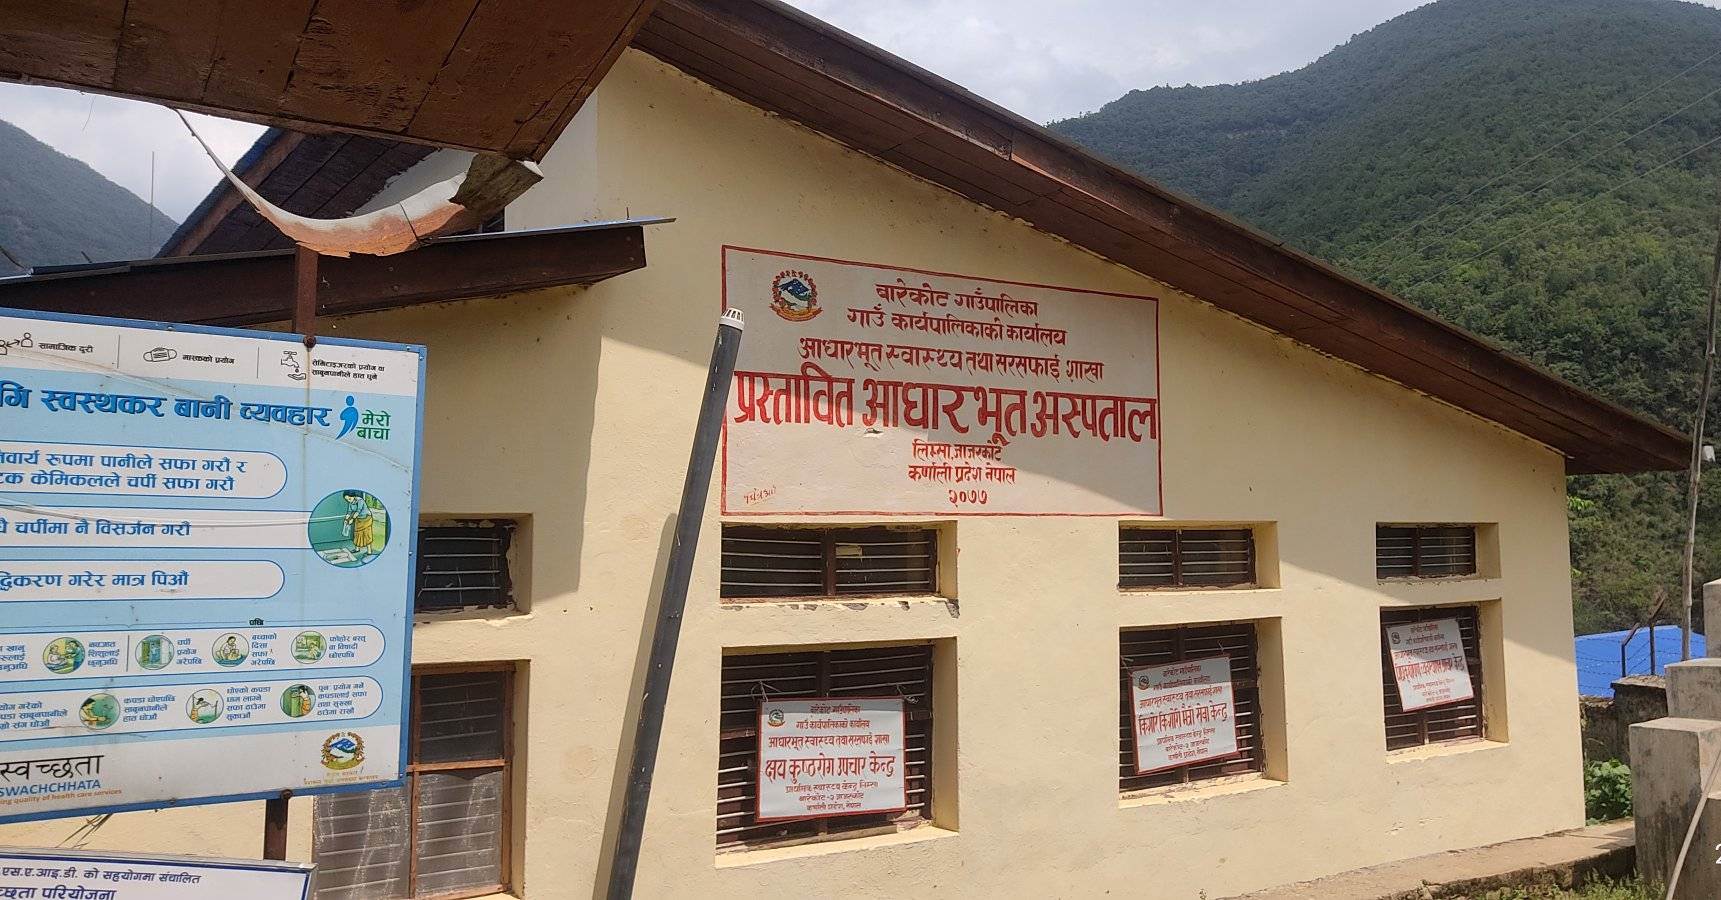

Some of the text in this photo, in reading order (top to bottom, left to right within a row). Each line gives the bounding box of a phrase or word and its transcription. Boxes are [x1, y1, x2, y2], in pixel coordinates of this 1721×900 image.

[875, 278, 1039, 317] बारेकोट गाउँपालिका
[847, 303, 1068, 347] गाउँ कार्यपालिकाको कार्यालय
[38, 342, 77, 352] सामाजिक
[182, 354, 236, 365] मास्कको प्रयोग
[358, 363, 377, 372] प्रयोग
[799, 337, 883, 372] आधारभूत
[966, 352, 993, 375] तथा
[995, 354, 1060, 383] सरसफाई
[1066, 359, 1104, 383] शाखा
[41, 389, 167, 417] स्वस्थकर
[174, 393, 232, 420] बानी
[240, 402, 332, 427] व्यवहार
[734, 361, 855, 427] प्रस्तावित
[1031, 390, 1158, 442] अस्पताल
[361, 409, 391, 427] मेरो
[356, 427, 391, 440] बाचा
[45, 453, 95, 467] रूपमा
[101, 453, 153, 470] पानीले
[159, 457, 197, 472] सफा
[236, 461, 248, 473] र
[31, 469, 121, 488] केमिकलले
[126, 473, 156, 489] चर्पी
[162, 476, 200, 490] सफा
[908, 462, 1016, 485] कर्णाली प्रदेश नेपाल
[948, 489, 988, 508] २०७७
[15, 519, 69, 534] चर्पीमा
[75, 519, 90, 535] नै
[95, 519, 155, 536] विसर्जन
[68, 570, 107, 587] गरेर
[112, 573, 146, 587] मात्र
[251, 641, 268, 649] दिसा
[251, 650, 268, 658] सफा
[123, 714, 137, 722] हात
[0, 755, 104, 782] स्वच्छता
[869, 750, 896, 777] केन्द्र
[0, 780, 101, 797] SWACHCHHATA
[14, 795, 41, 804] quality
[42, 793, 50, 801] of
[52, 792, 75, 801] health
[93, 788, 122, 797] services
[83, 867, 99, 879] को
[102, 869, 154, 883] सहयोगमा
[158, 872, 201, 885] संचालित
[42, 884, 117, 900] परियोजना
